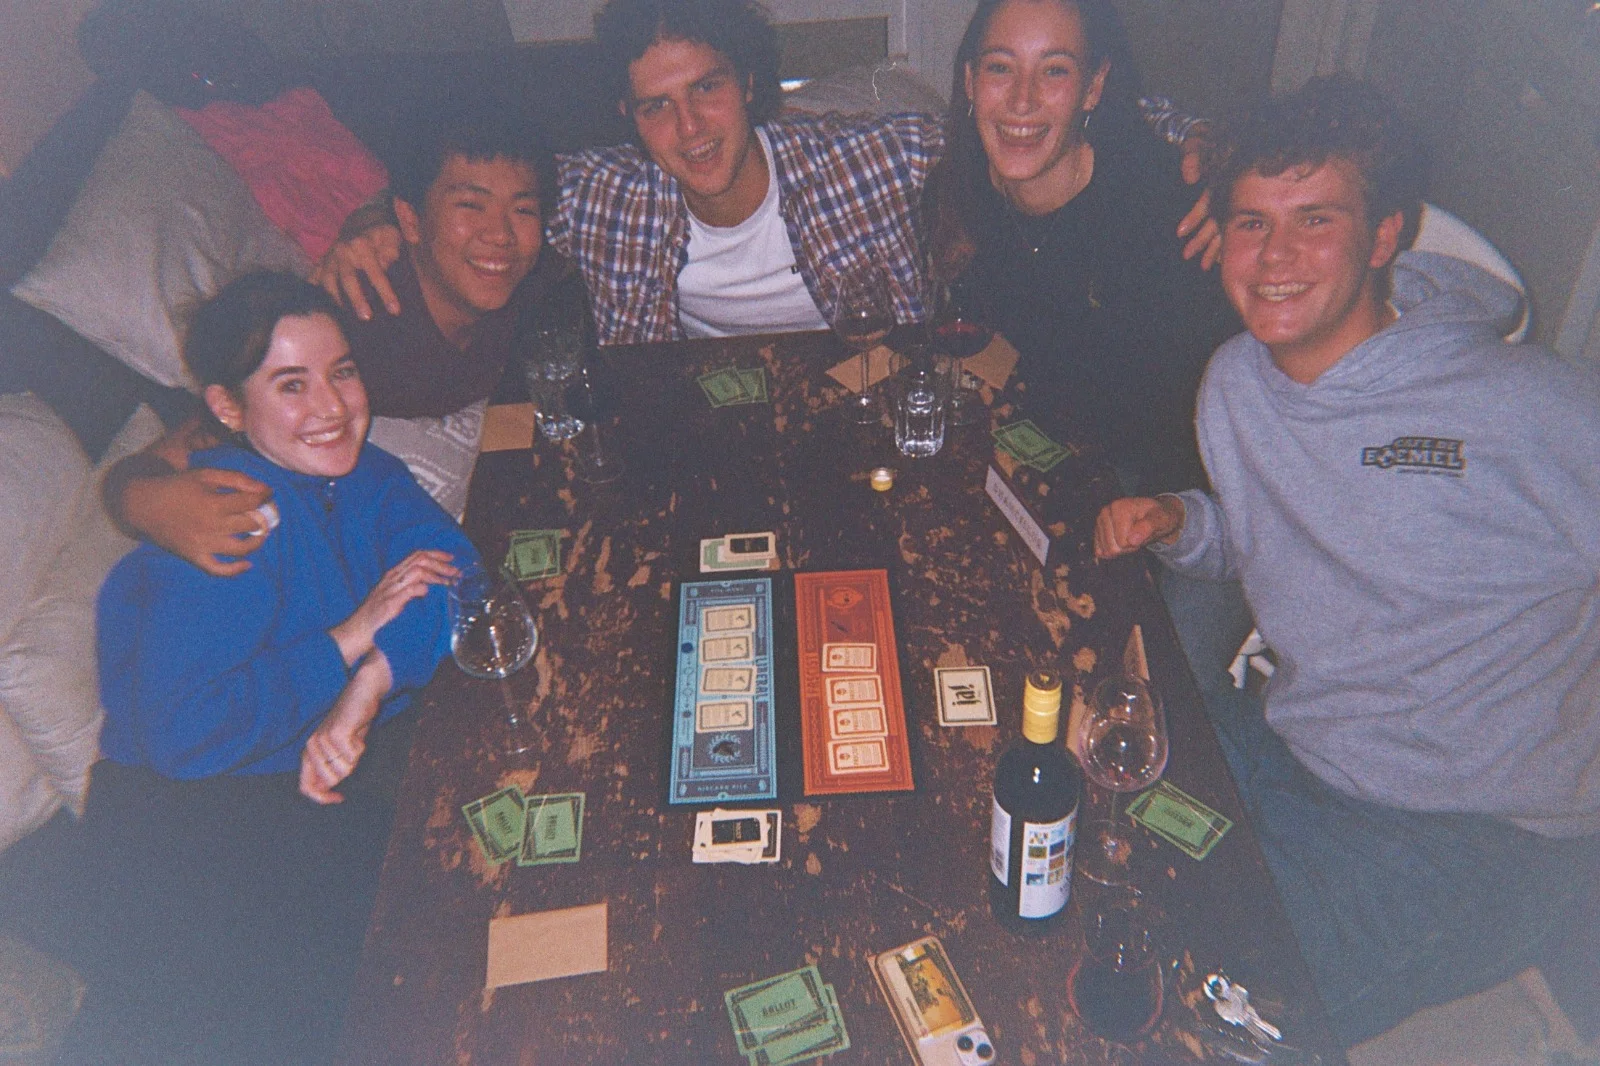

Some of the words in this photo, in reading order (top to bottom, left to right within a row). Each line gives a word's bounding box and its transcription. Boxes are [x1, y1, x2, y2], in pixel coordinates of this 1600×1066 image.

[756, 656, 769, 701] LIBERAL
[806, 652, 819, 696] FASCIST
[762, 999, 796, 1016] BALLOT
